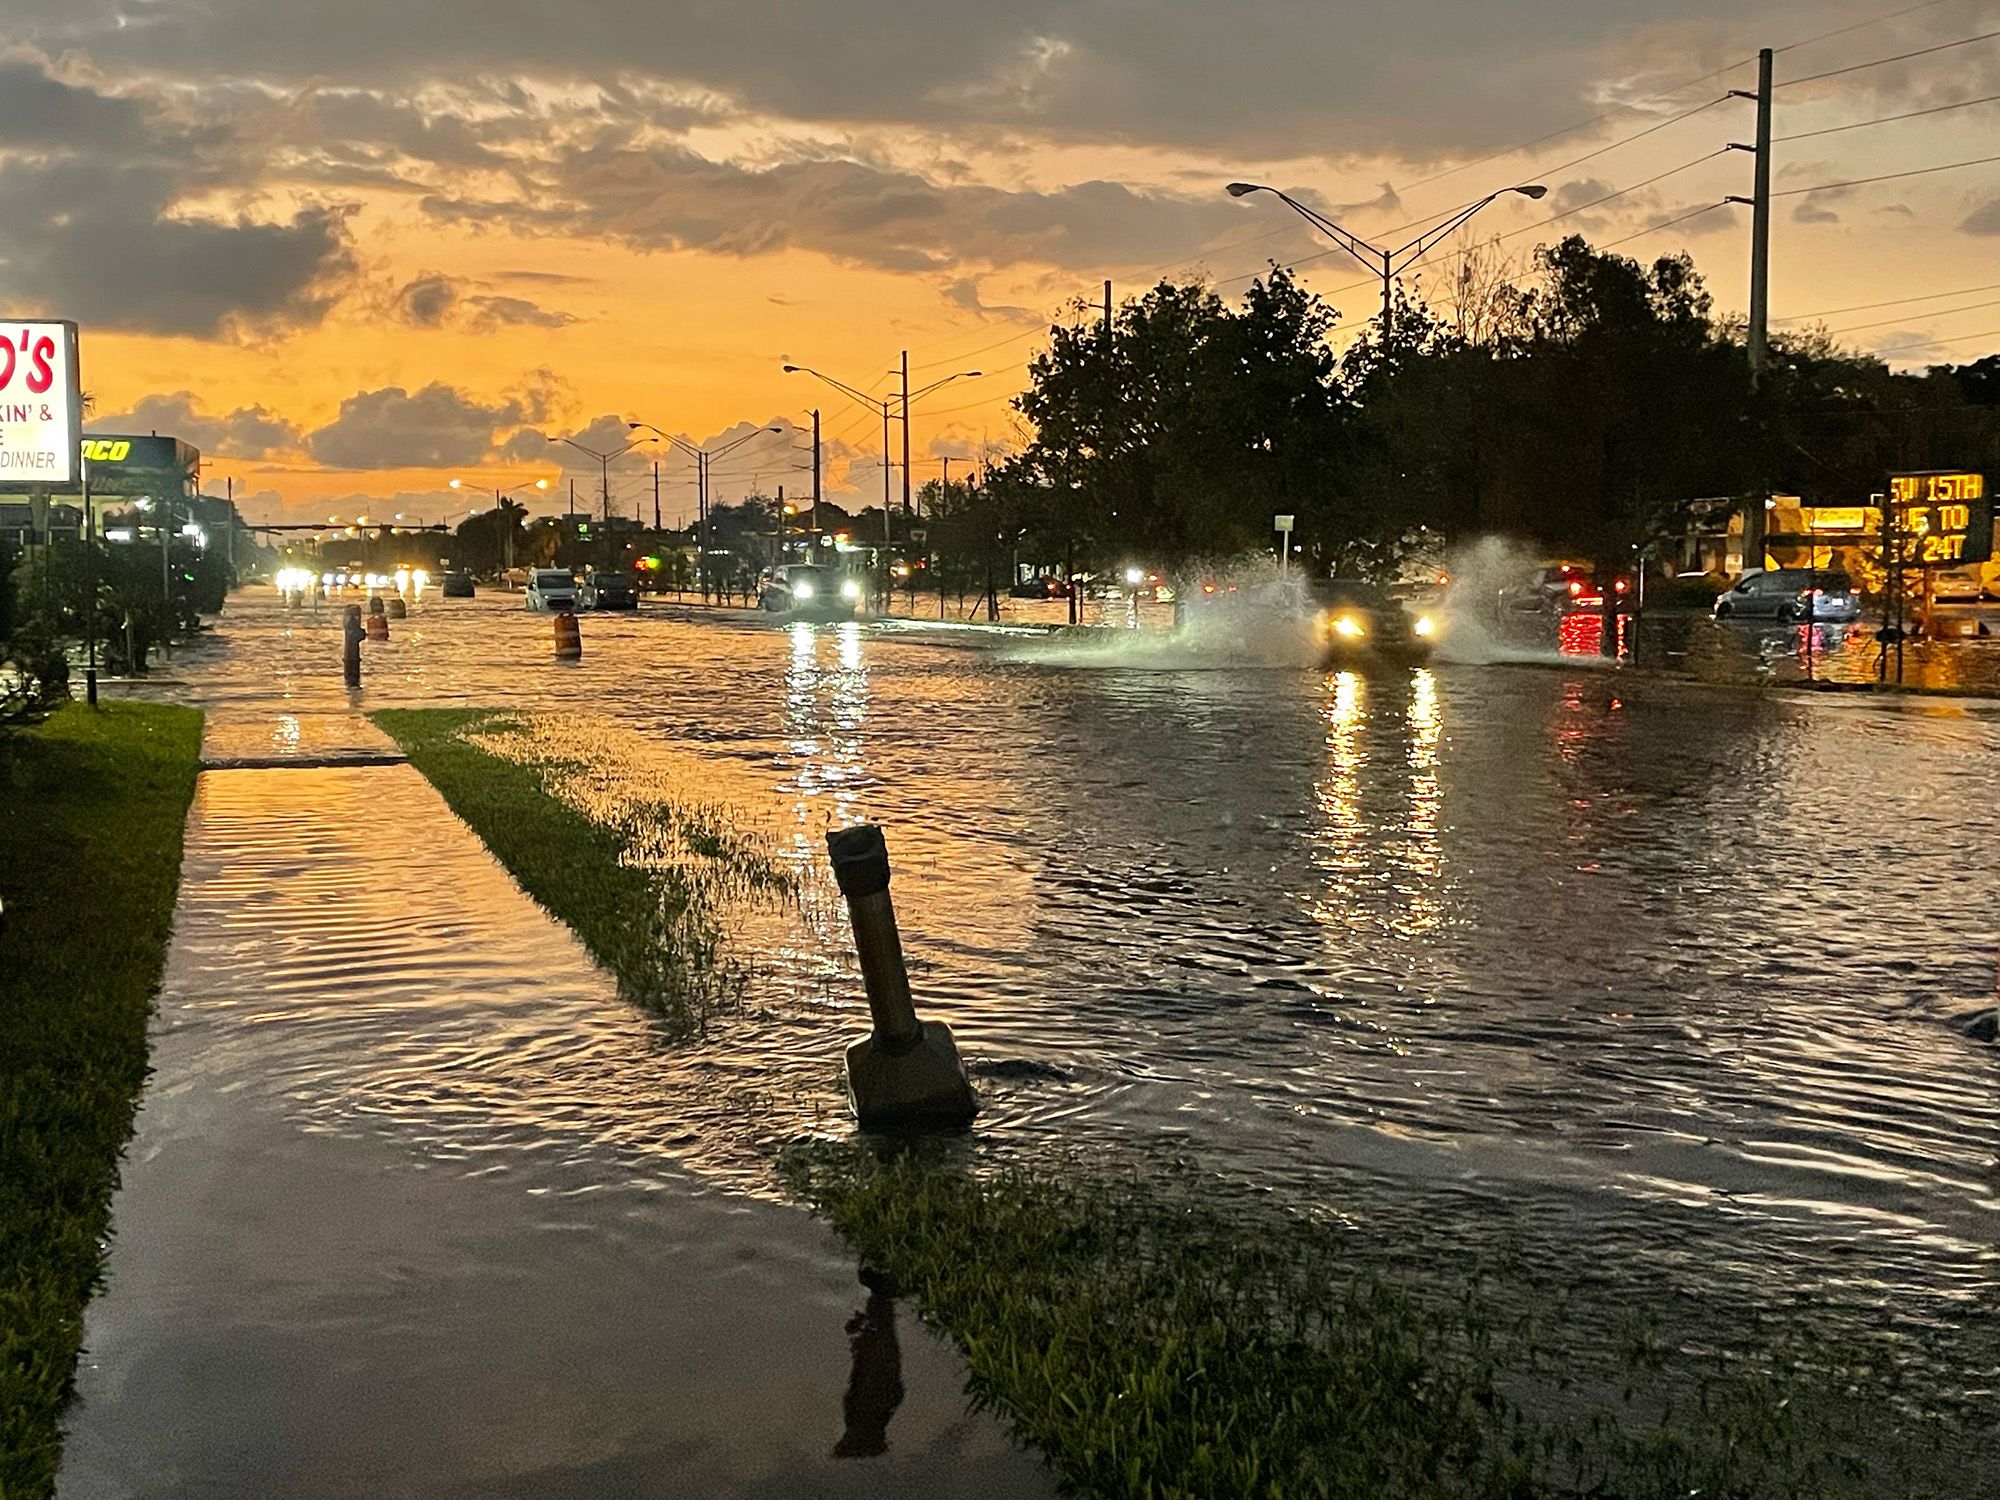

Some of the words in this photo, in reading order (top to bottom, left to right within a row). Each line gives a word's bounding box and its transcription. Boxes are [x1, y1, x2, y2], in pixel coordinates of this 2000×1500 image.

[39, 403, 52, 422] &
[0, 450, 56, 469] DINNER
[1927, 475, 1982, 501] 15TH
[1937, 504, 1968, 530] TO
